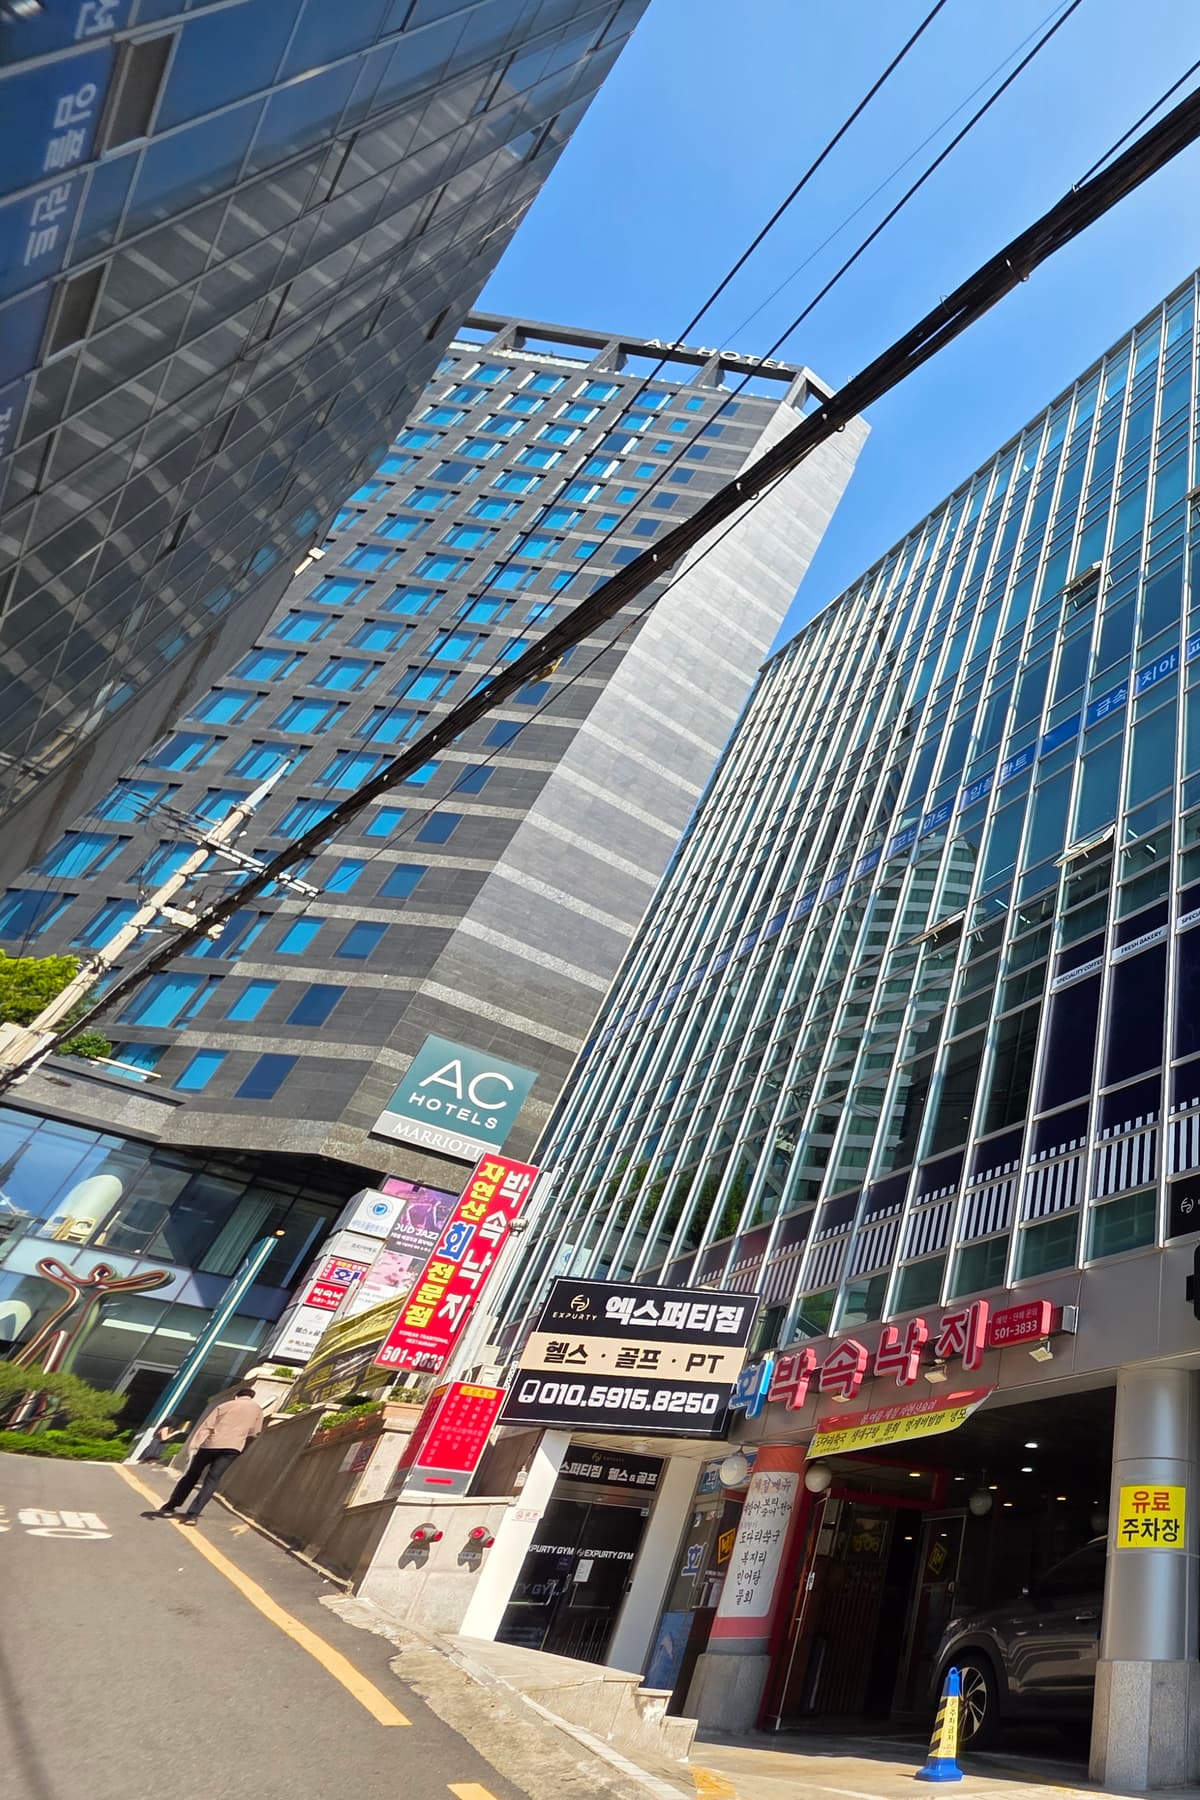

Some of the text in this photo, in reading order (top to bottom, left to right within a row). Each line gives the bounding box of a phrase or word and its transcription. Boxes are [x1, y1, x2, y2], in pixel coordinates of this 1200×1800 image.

[24, 83, 97, 267] 임플란트
[643, 338, 792, 371] AC HOTEL
[1120, 940, 1139, 954] FRESH
[418, 1058, 515, 1111] AC
[408, 1092, 499, 1131] HOTELS
[391, 1121, 485, 1159] MARRIOTT
[461, 1161, 507, 1222] 자연산
[415, 1227, 439, 1240] JAZZ
[436, 1220, 478, 1263] 회
[437, 1169, 531, 1334] 박속낙지
[403, 1261, 456, 1329] 전문점
[552, 1311, 599, 1322] EXPURTY
[604, 1295, 745, 1335] 엑스퍼티짐
[994, 1319, 1039, 1341] 501-3833
[380, 1345, 445, 1371] 501-3833
[543, 1340, 725, 1374] 헬스 골프 PT
[767, 1299, 990, 1412] 박속낙지
[540, 1383, 720, 1415] 010.5915.8250
[559, 1460, 604, 1478] 스퍼티짐
[1131, 1490, 1172, 1514] 유료
[1122, 1517, 1181, 1543] 주차장
[528, 1544, 575, 1556] XPURTY GYM
[584, 1549, 635, 1561] EXPURTY GYM
